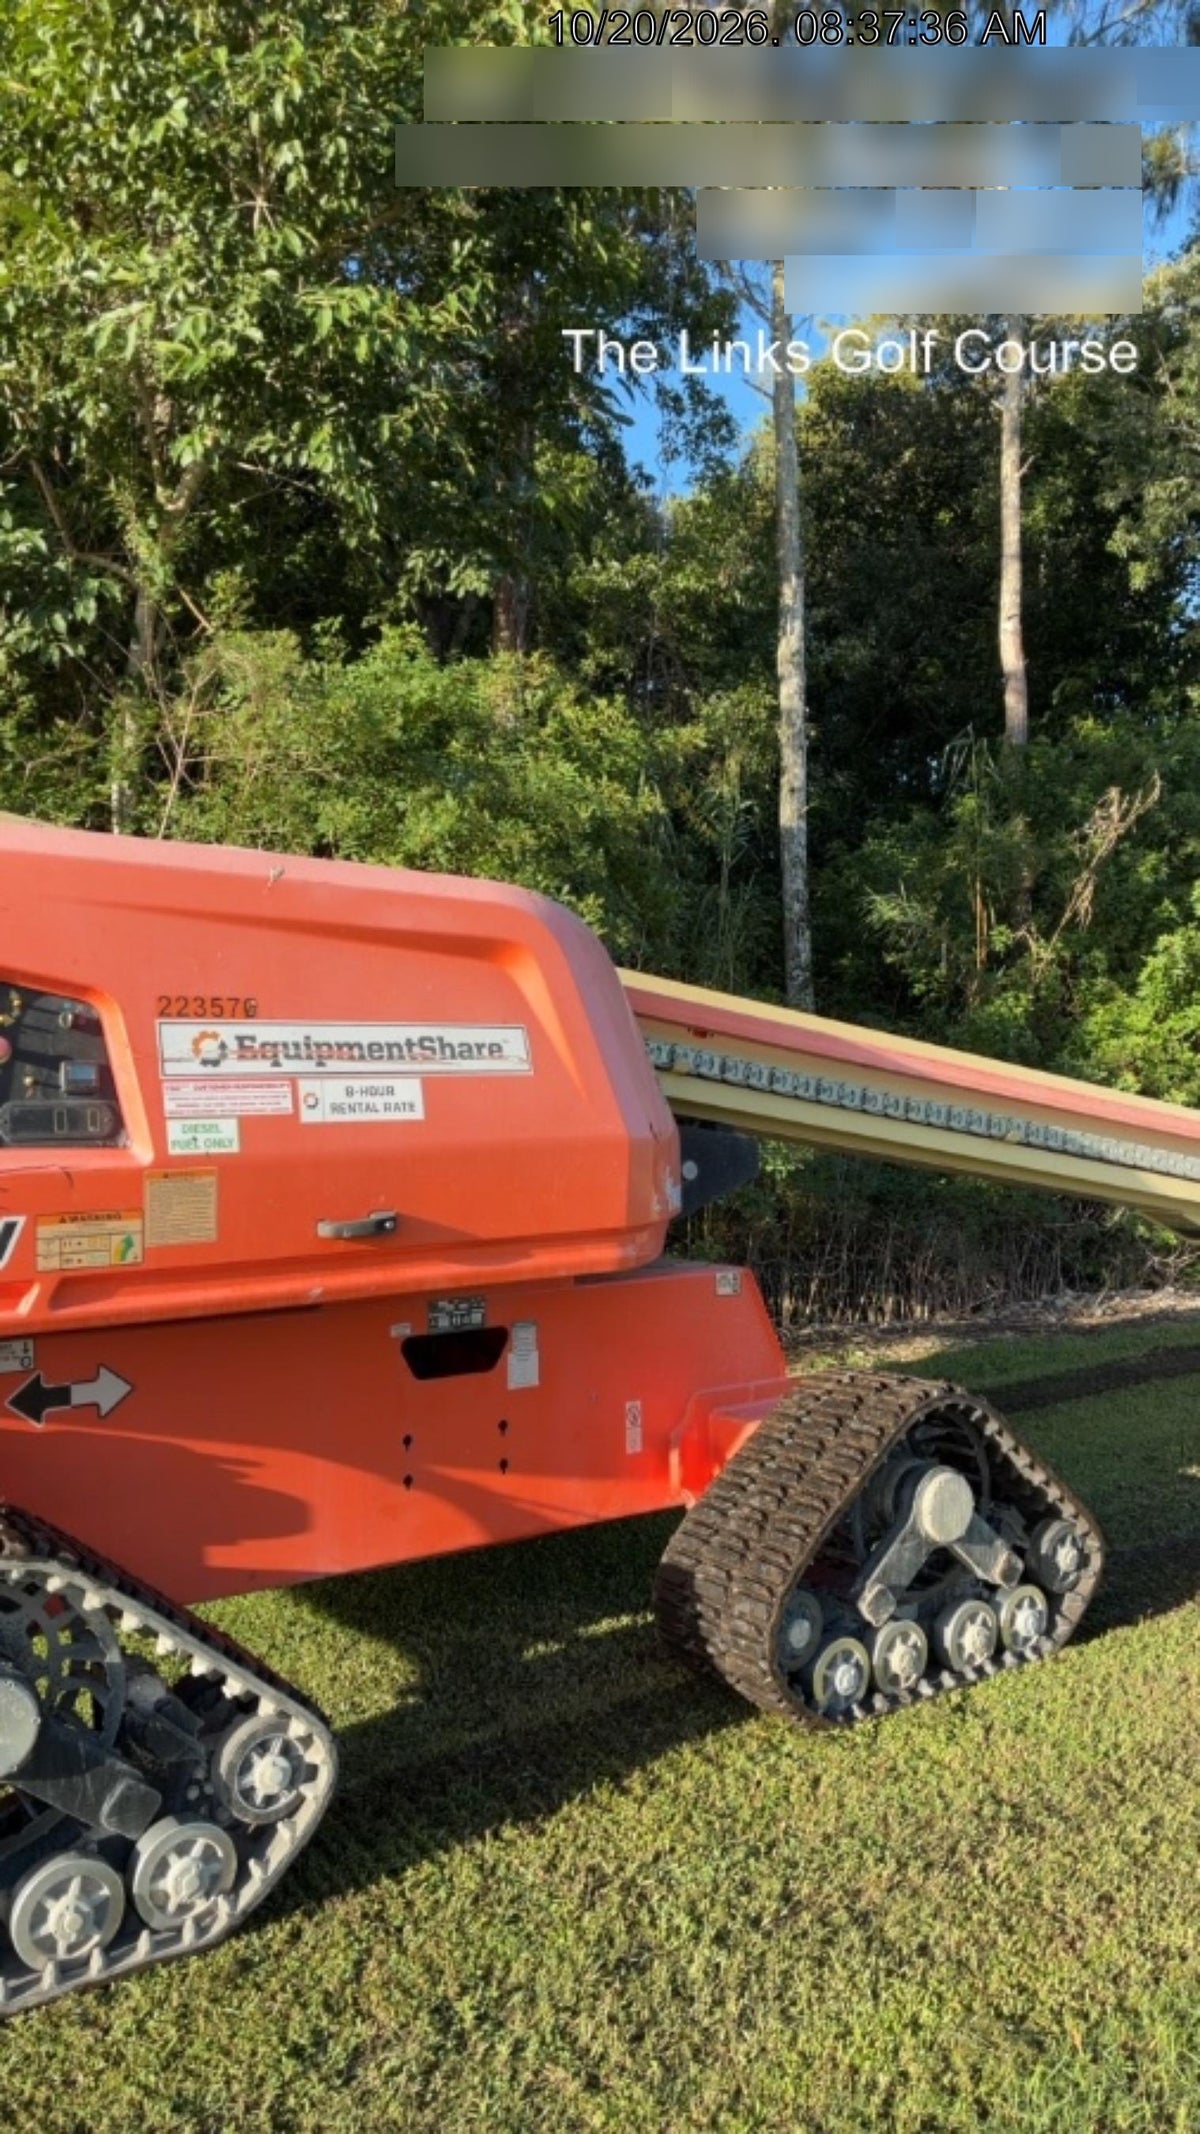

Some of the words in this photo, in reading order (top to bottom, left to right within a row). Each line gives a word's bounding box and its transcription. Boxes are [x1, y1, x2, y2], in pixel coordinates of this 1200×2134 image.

[234, 1035, 504, 1068] EquipmentShare
[345, 1085, 396, 1097] 8-HOUR
[330, 1103, 381, 1115] RENTAL
[383, 1101, 416, 1113] RATE
[181, 1123, 223, 1134] DIESEL
[203, 1137, 235, 1149] ONLY
